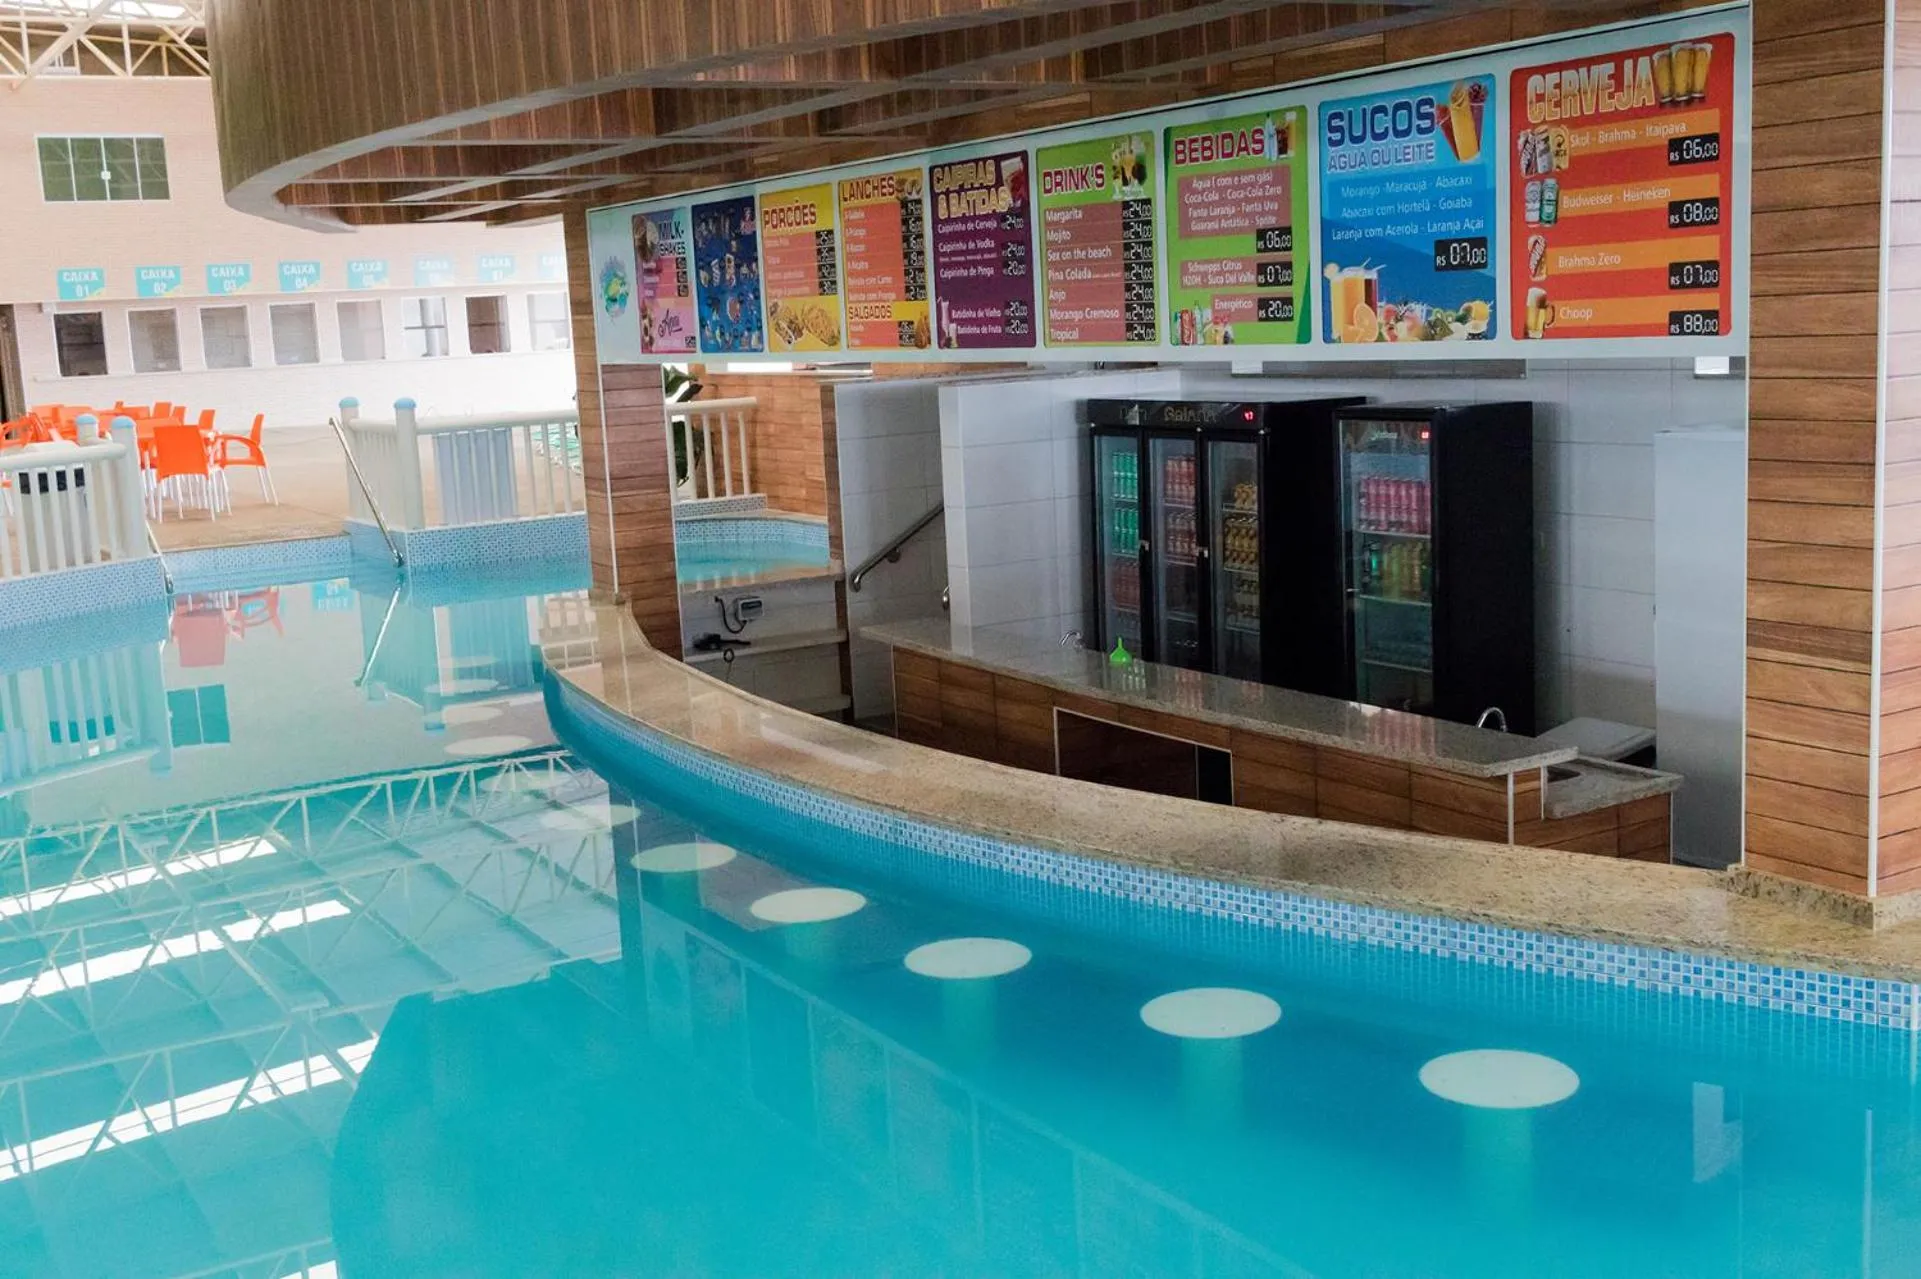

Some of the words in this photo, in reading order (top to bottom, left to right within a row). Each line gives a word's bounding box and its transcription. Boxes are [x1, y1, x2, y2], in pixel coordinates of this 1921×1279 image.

[1527, 56, 1655, 124] CERVEJA
[1327, 97, 1436, 148] SUCOS
[1569, 131, 1590, 147] Skol
[1599, 130, 1636, 145] Brahma
[1646, 123, 1687, 139] Itaipava
[1174, 127, 1265, 165] BEBIDAS
[1371, 147, 1391, 166] OU
[1395, 142, 1435, 164] LEITE
[933, 159, 996, 193] CAIPIRAS
[1042, 162, 1105, 196] DRINK'S
[841, 175, 895, 202] LANCHES
[1184, 190, 1219, 204] Coca-Cola
[1264, 185, 1282, 196] Zero
[1341, 185, 1380, 199] Morango
[1435, 174, 1473, 188] Abacaxi
[949, 186, 1012, 218] BATIDAS
[1563, 193, 1613, 209] Budweiser
[1623, 186, 1671, 202] Heineken
[1045, 206, 1083, 223] Margarita
[1210, 204, 1235, 219] Laranja
[1241, 201, 1262, 214] Fanta
[1341, 206, 1374, 219] Abacaxi
[1375, 206, 1395, 216] com
[1438, 197, 1473, 210] Goiaba
[1046, 230, 1072, 243] Mojito
[1332, 228, 1363, 242] Laranja
[1364, 226, 1384, 237] com
[1385, 223, 1419, 237] Acerola
[1427, 219, 1461, 235] Laranja
[1047, 249, 1060, 262] Sex
[1061, 250, 1072, 260] on
[1073, 247, 1087, 260] the
[1087, 245, 1112, 259] beach
[1558, 255, 1595, 268] Brahma
[1598, 253, 1621, 266] Zero
[63, 270, 98, 282] CAIXA
[141, 268, 175, 280] CAIXA
[211, 265, 245, 278] CAIXA
[282, 263, 316, 275] CAIXA
[351, 261, 383, 273] CAIXA
[1065, 267, 1092, 280] Colada
[75, 284, 89, 297] 01
[153, 281, 167, 294] 02
[848, 304, 892, 320] SALGADOS
[1085, 307, 1120, 320] Cremoso
